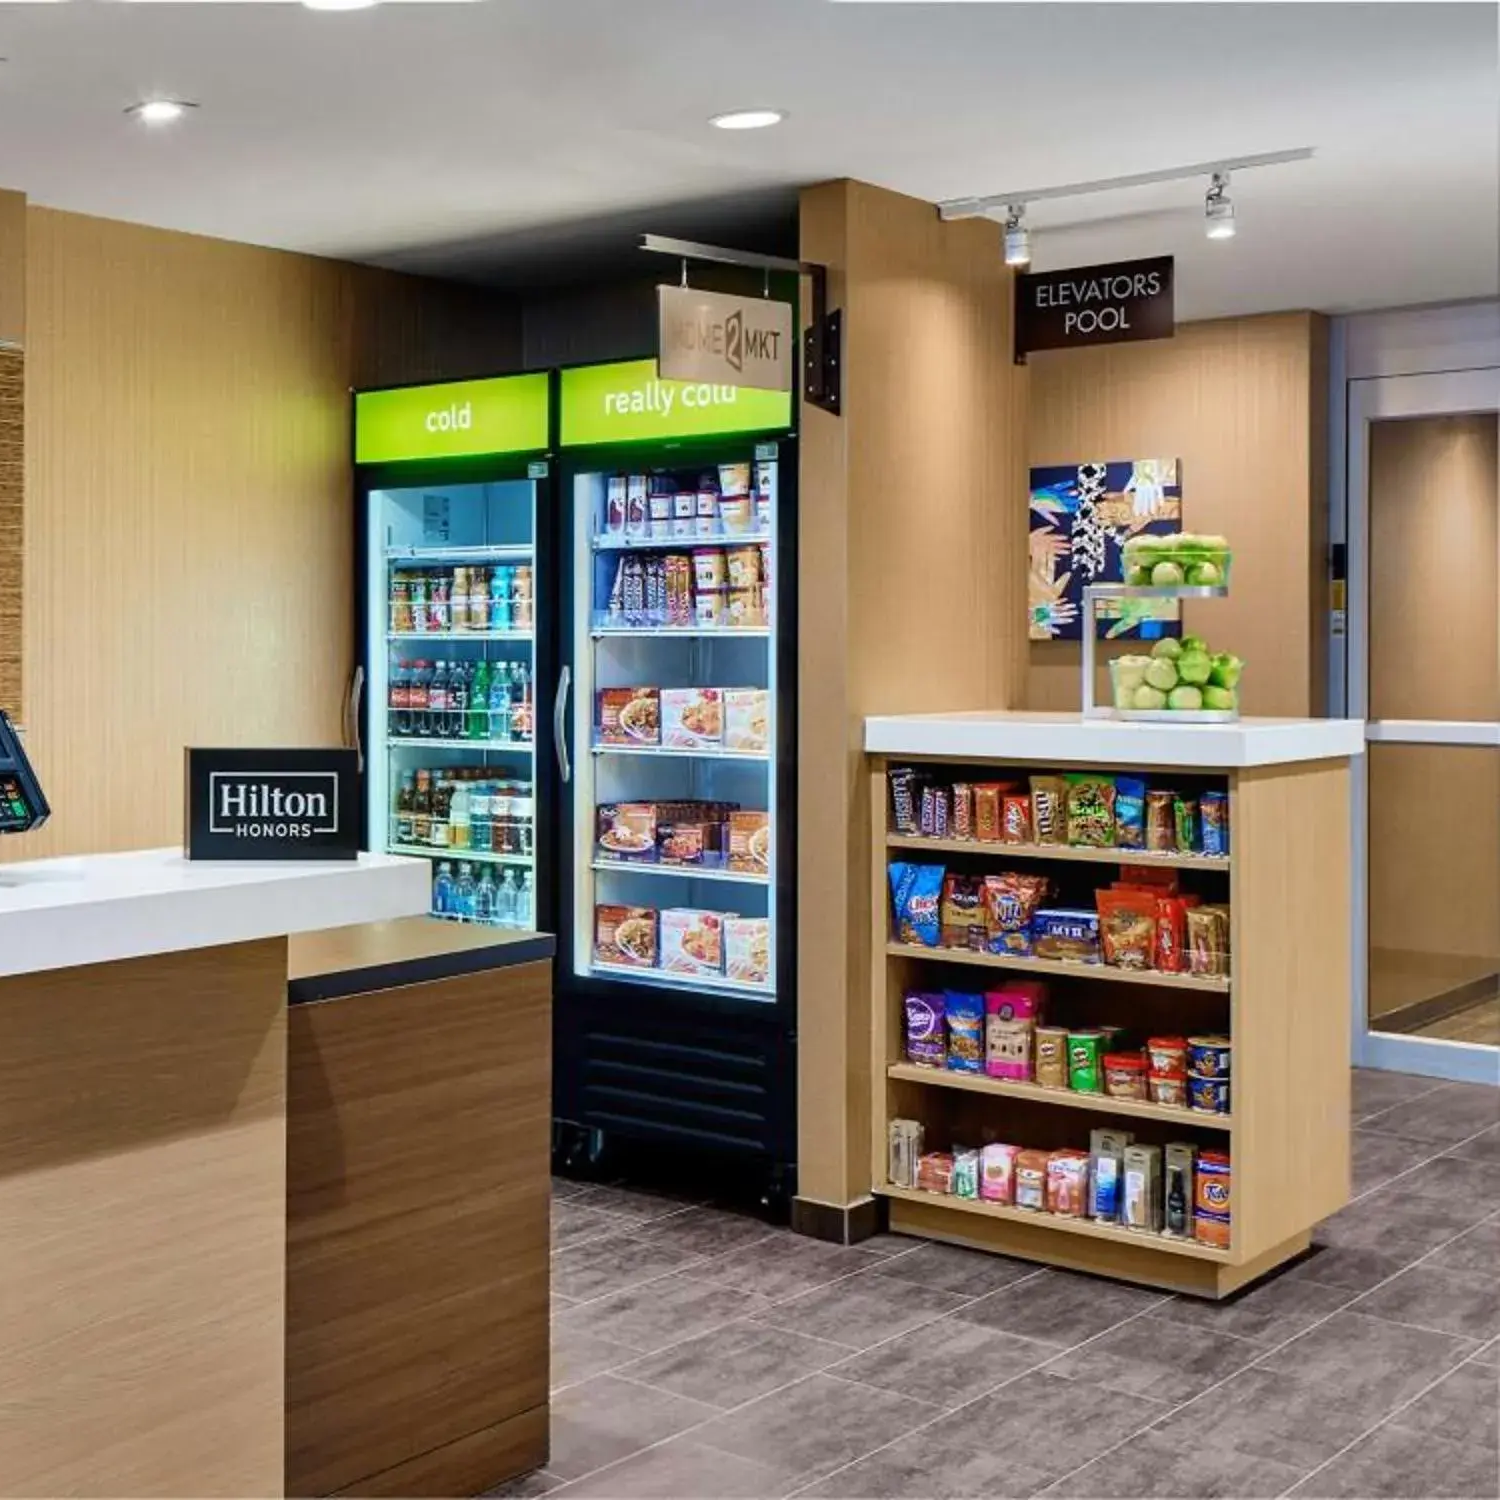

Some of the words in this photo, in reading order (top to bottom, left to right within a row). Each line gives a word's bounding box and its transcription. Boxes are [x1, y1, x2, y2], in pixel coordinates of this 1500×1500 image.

[1035, 272, 1161, 307] ELEVATORS
[1065, 306, 1131, 335] POOL
[745, 329, 781, 361] MKT
[605, 380, 675, 416] really
[426, 402, 472, 432] cold
[220, 783, 328, 817] Hilton
[236, 823, 312, 837] HONORS
